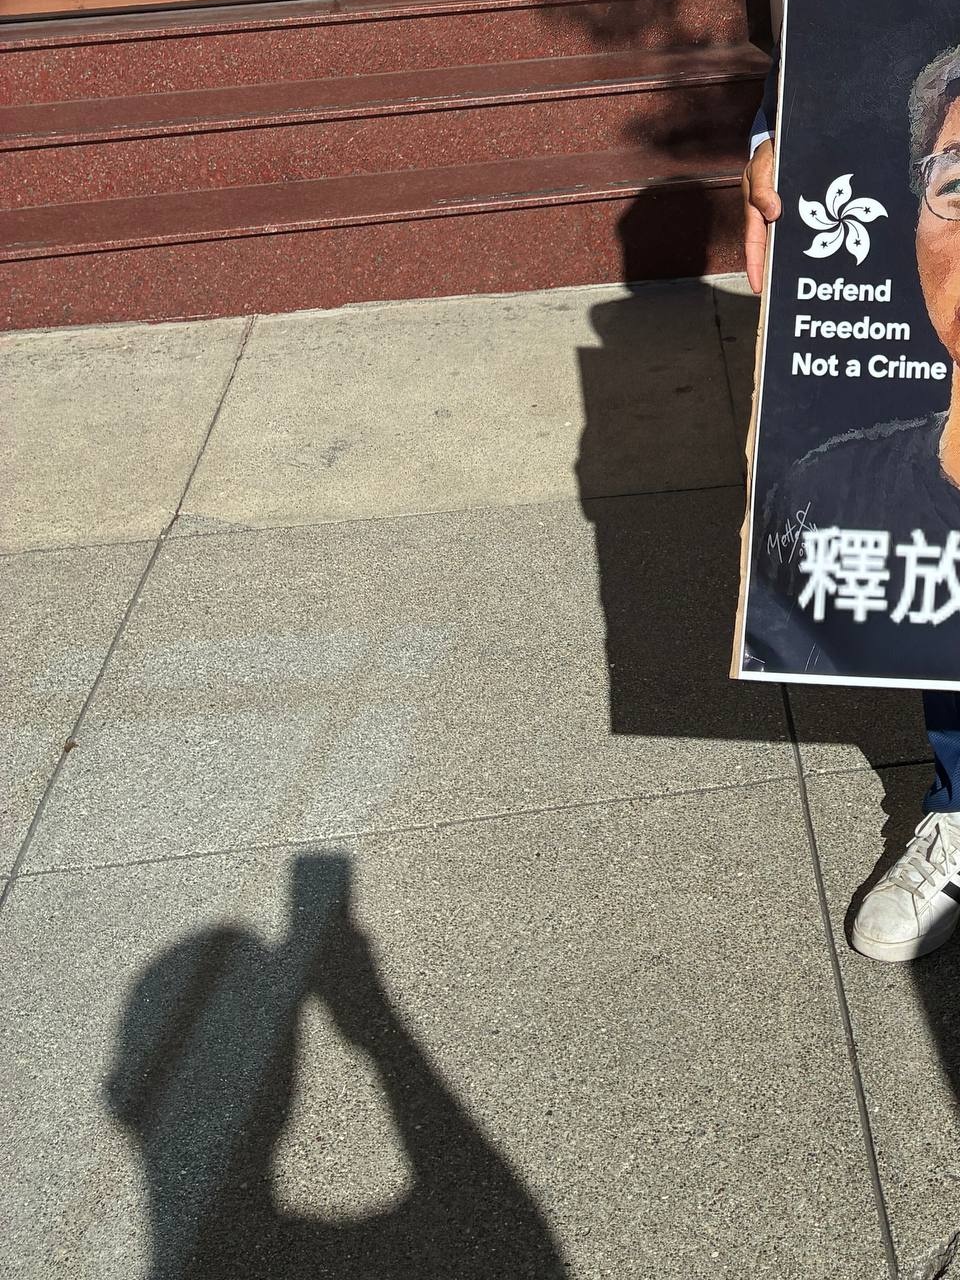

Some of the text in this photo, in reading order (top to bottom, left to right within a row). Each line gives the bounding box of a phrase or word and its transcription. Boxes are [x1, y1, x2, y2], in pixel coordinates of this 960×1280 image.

[796, 277, 892, 302] Defend
[794, 315, 910, 340] Freedom
[791, 352, 947, 379] Not a Crime
